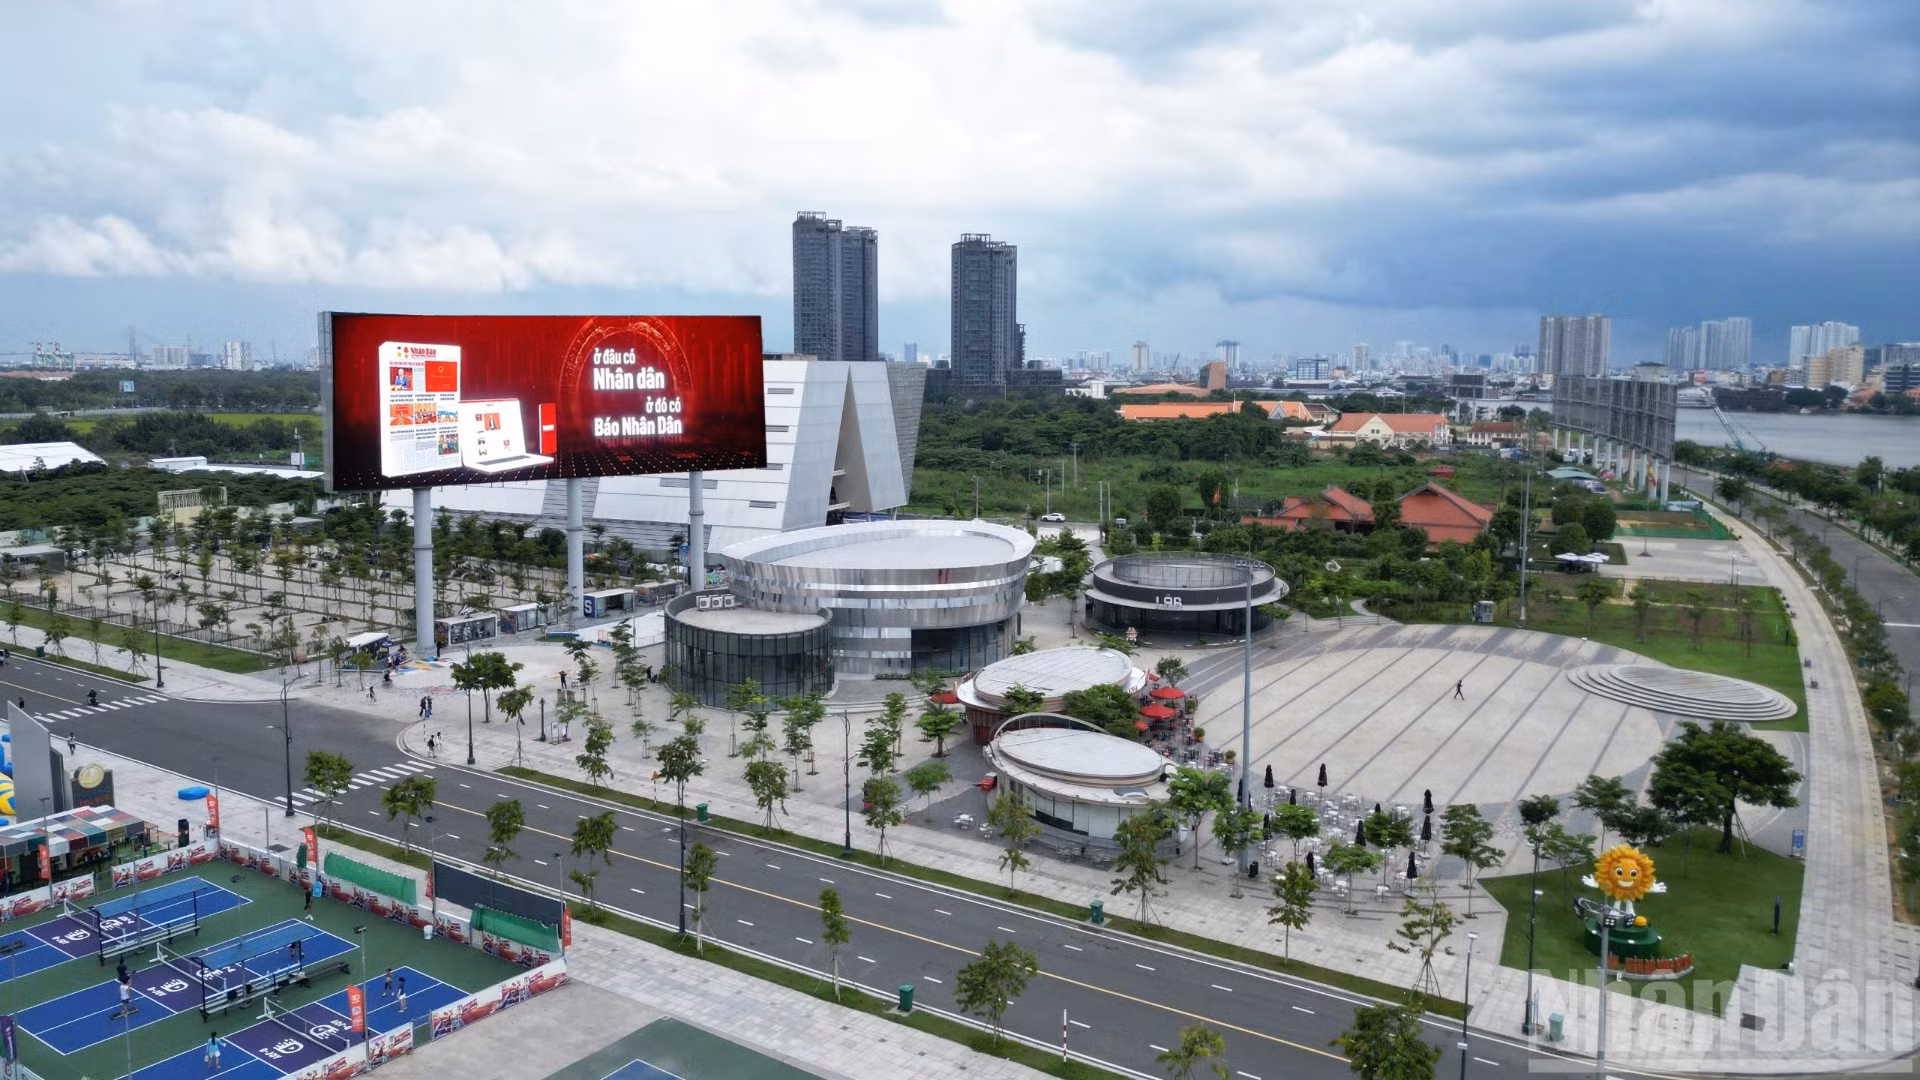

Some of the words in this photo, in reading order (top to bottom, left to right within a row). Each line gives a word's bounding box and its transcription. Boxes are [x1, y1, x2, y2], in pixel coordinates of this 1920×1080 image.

[593, 347, 602, 365] ở
[603, 348, 622, 365] đâu
[623, 347, 636, 364] có
[593, 367, 634, 390] Nhân
[637, 366, 665, 389] dân
[646, 396, 654, 413] ở
[655, 397, 667, 413] đó
[669, 397, 681, 412] có
[594, 417, 620, 437] Báo
[621, 416, 656, 436] Nhân
[657, 416, 683, 435] Dân
[584, 599, 592, 614] S
